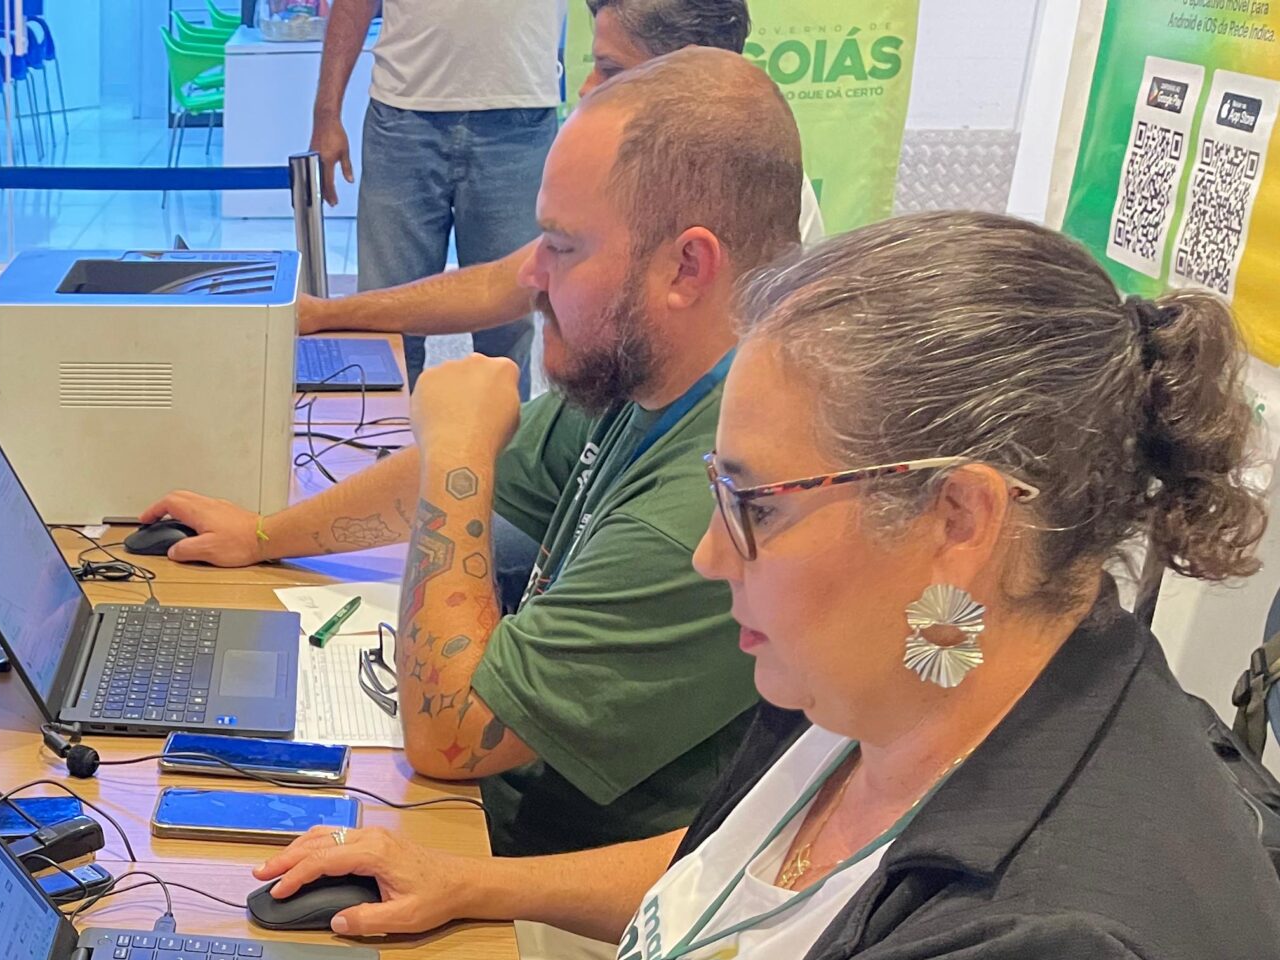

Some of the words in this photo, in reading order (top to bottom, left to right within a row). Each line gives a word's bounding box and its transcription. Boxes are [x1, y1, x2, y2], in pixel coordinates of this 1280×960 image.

[1250, 1, 1269, 16] para
[759, 24, 842, 35] OVERNO
[870, 22, 891, 30] DE
[1168, 12, 1197, 30] Android
[1202, 16, 1217, 33] iOS
[1218, 22, 1228, 34] da
[1228, 20, 1248, 37] Rede
[798, 90, 823, 100] QUE
[826, 88, 842, 98] DÁ
[845, 86, 884, 97] CERTO
[1228, 108, 1240, 124] App
[1240, 110, 1255, 126] Store
